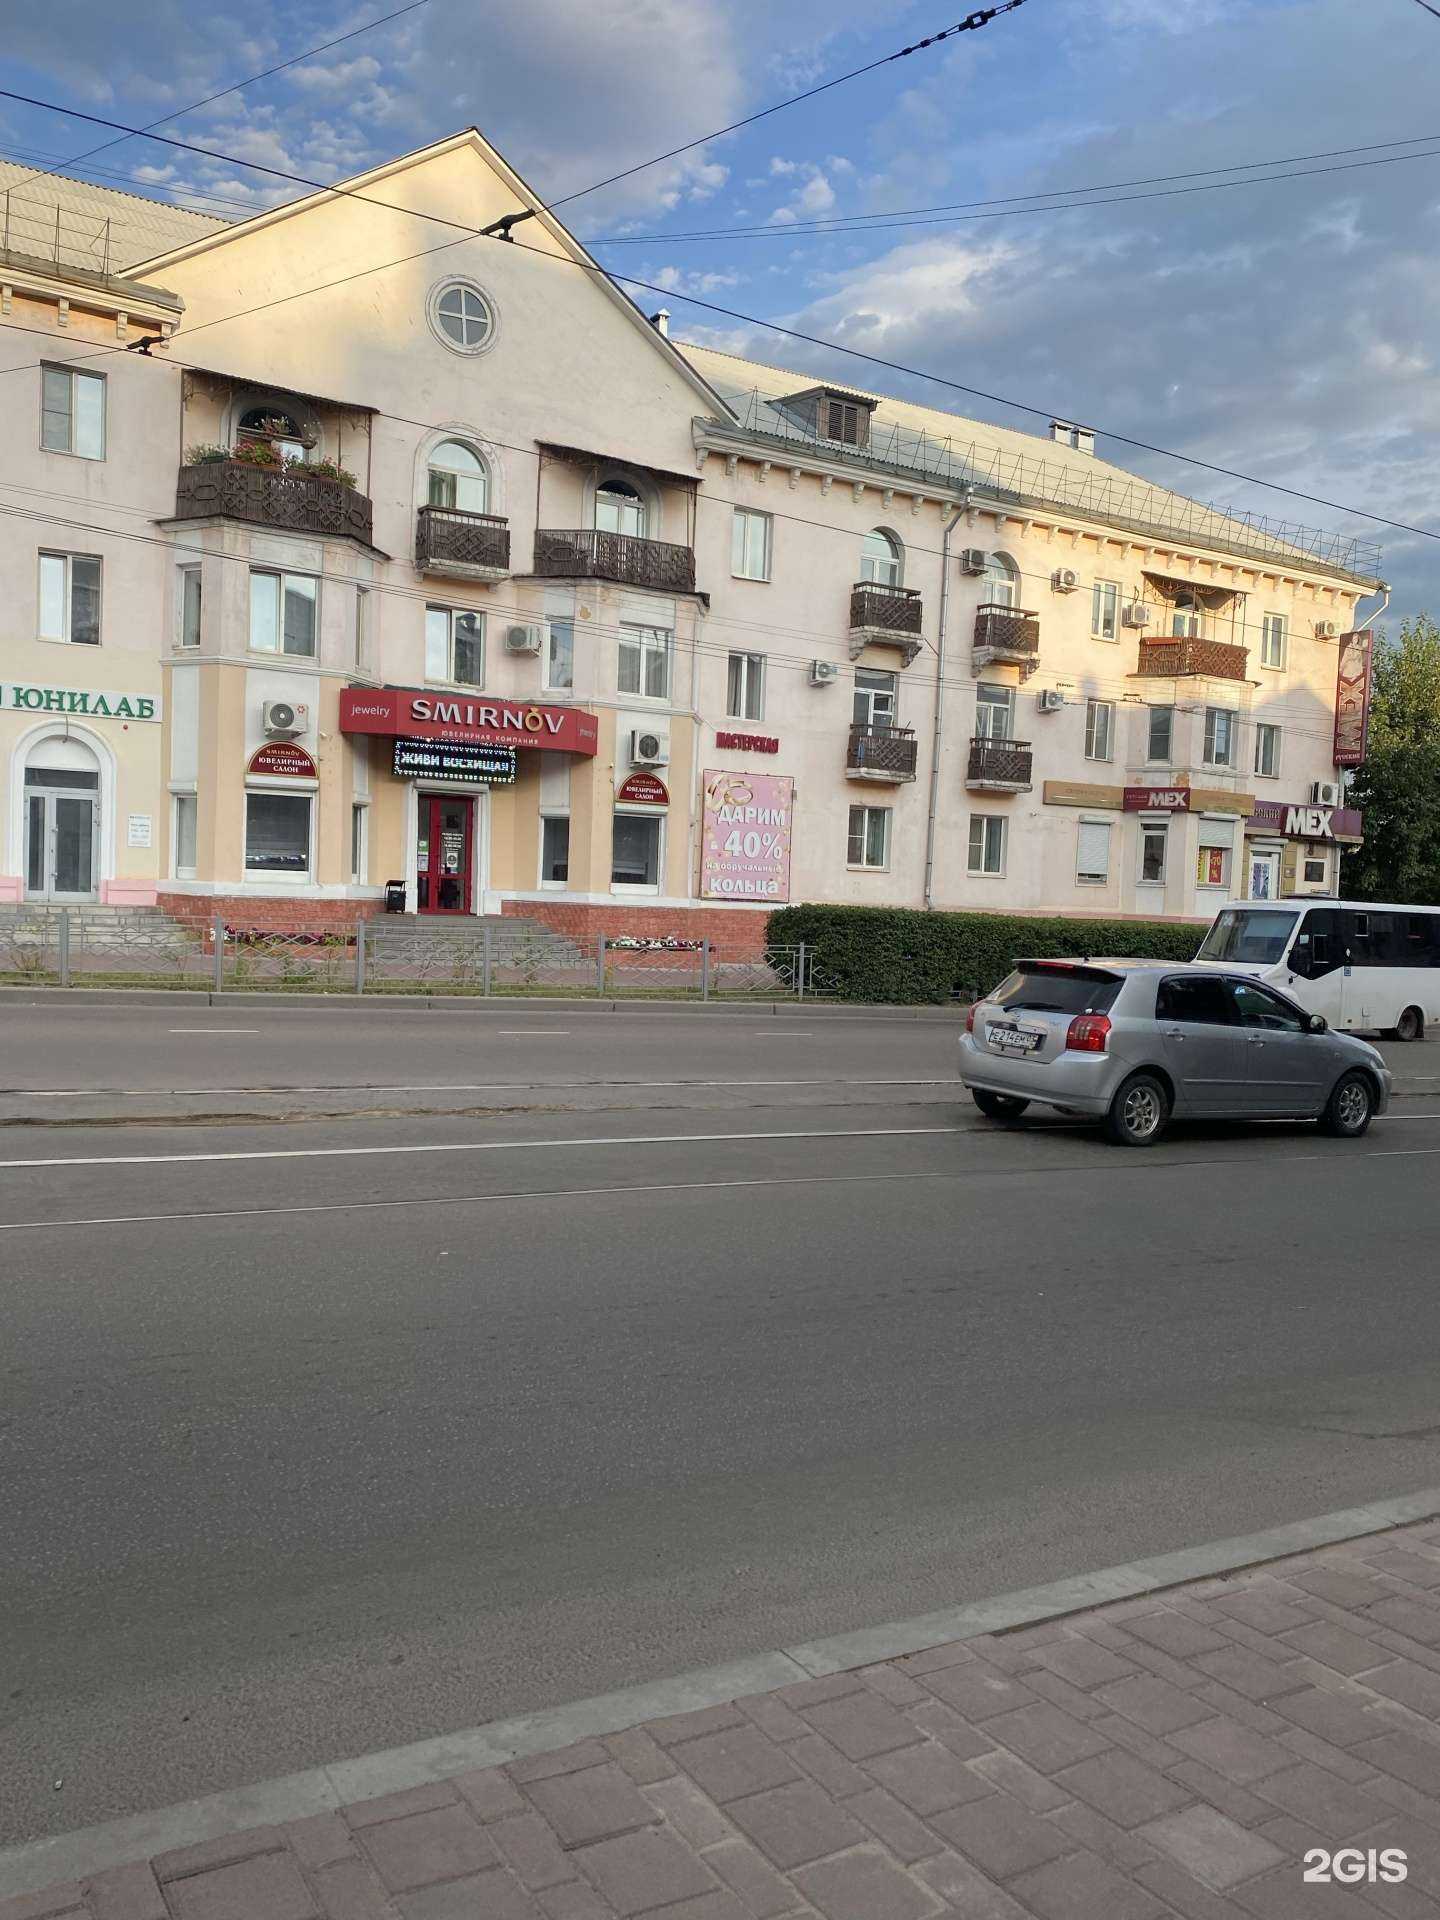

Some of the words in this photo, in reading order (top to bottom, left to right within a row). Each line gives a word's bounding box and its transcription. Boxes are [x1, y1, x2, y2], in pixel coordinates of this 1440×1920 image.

[12, 686, 155, 718] ЮНИЛАБ
[351, 704, 391, 719] jewelry
[411, 699, 565, 734] SMIRNOV
[441, 730, 491, 741] ЮВЕЛИРНАЯ
[495, 735, 539, 745] КОМПАНИЯ
[716, 732, 779, 753] МАСТЕРСКАЯ
[258, 757, 311, 767] ЮВЕЛИРНЫЙ
[400, 752, 440, 766] ЖИВИ
[626, 786, 663, 795] ЮВЕЛИРНЫЙ
[635, 793, 654, 801] САЛОН
[1147, 791, 1187, 807] МЕХ
[718, 806, 786, 827] ДАРИМ
[1284, 806, 1335, 838] МЕХ
[723, 830, 783, 860] 40%
